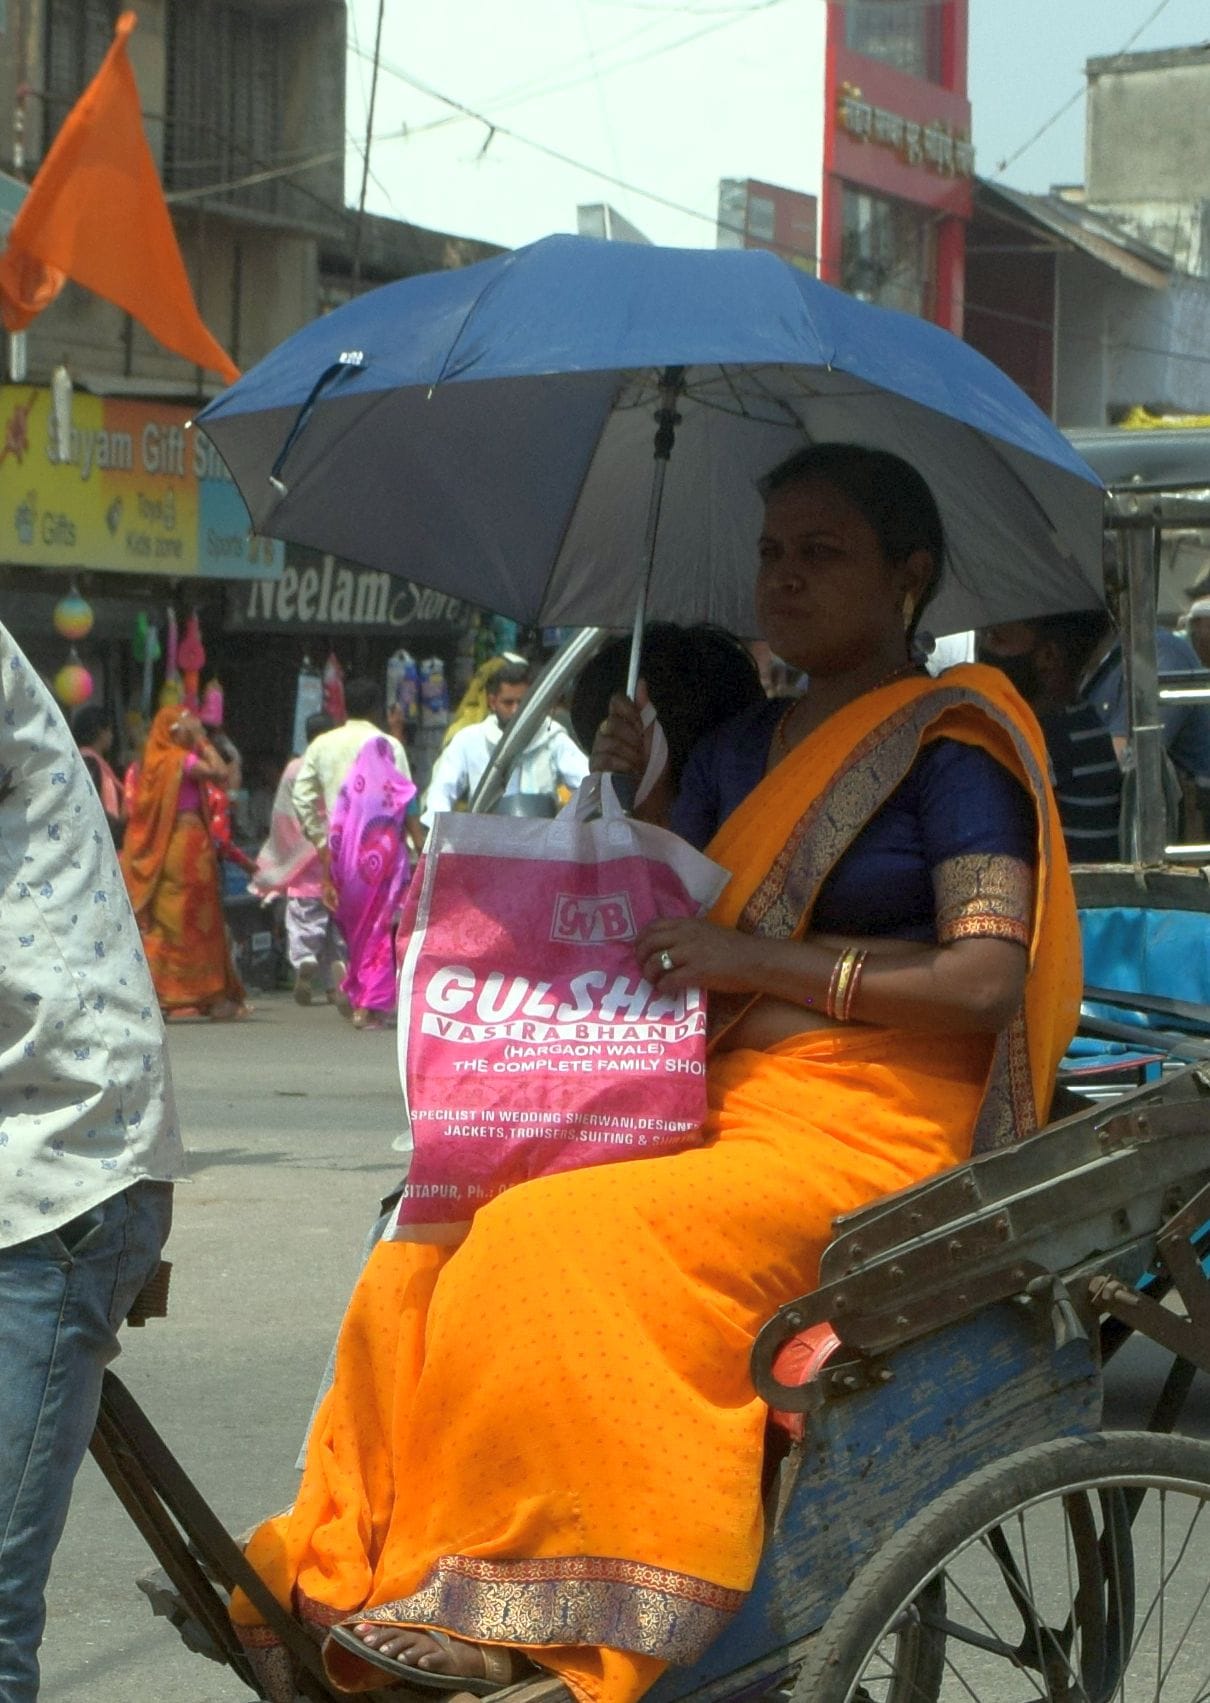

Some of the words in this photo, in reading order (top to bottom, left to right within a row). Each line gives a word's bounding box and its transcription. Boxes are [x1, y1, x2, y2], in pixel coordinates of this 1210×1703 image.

[142, 421, 185, 476] Gift
[247, 554, 391, 623] Neelam
[435, 1016, 561, 1041] VASTRA
[503, 1044, 602, 1059] (HARGAON
[606, 1043, 665, 1056] WALE)
[453, 1058, 488, 1072] THE
[493, 1059, 593, 1073] COMPLETE
[597, 1059, 661, 1072] FAMILY
[410, 1110, 476, 1121] SPECILIST
[481, 1110, 496, 1121] IN
[499, 1111, 561, 1123] WEDDING
[638, 1135, 648, 1146] &
